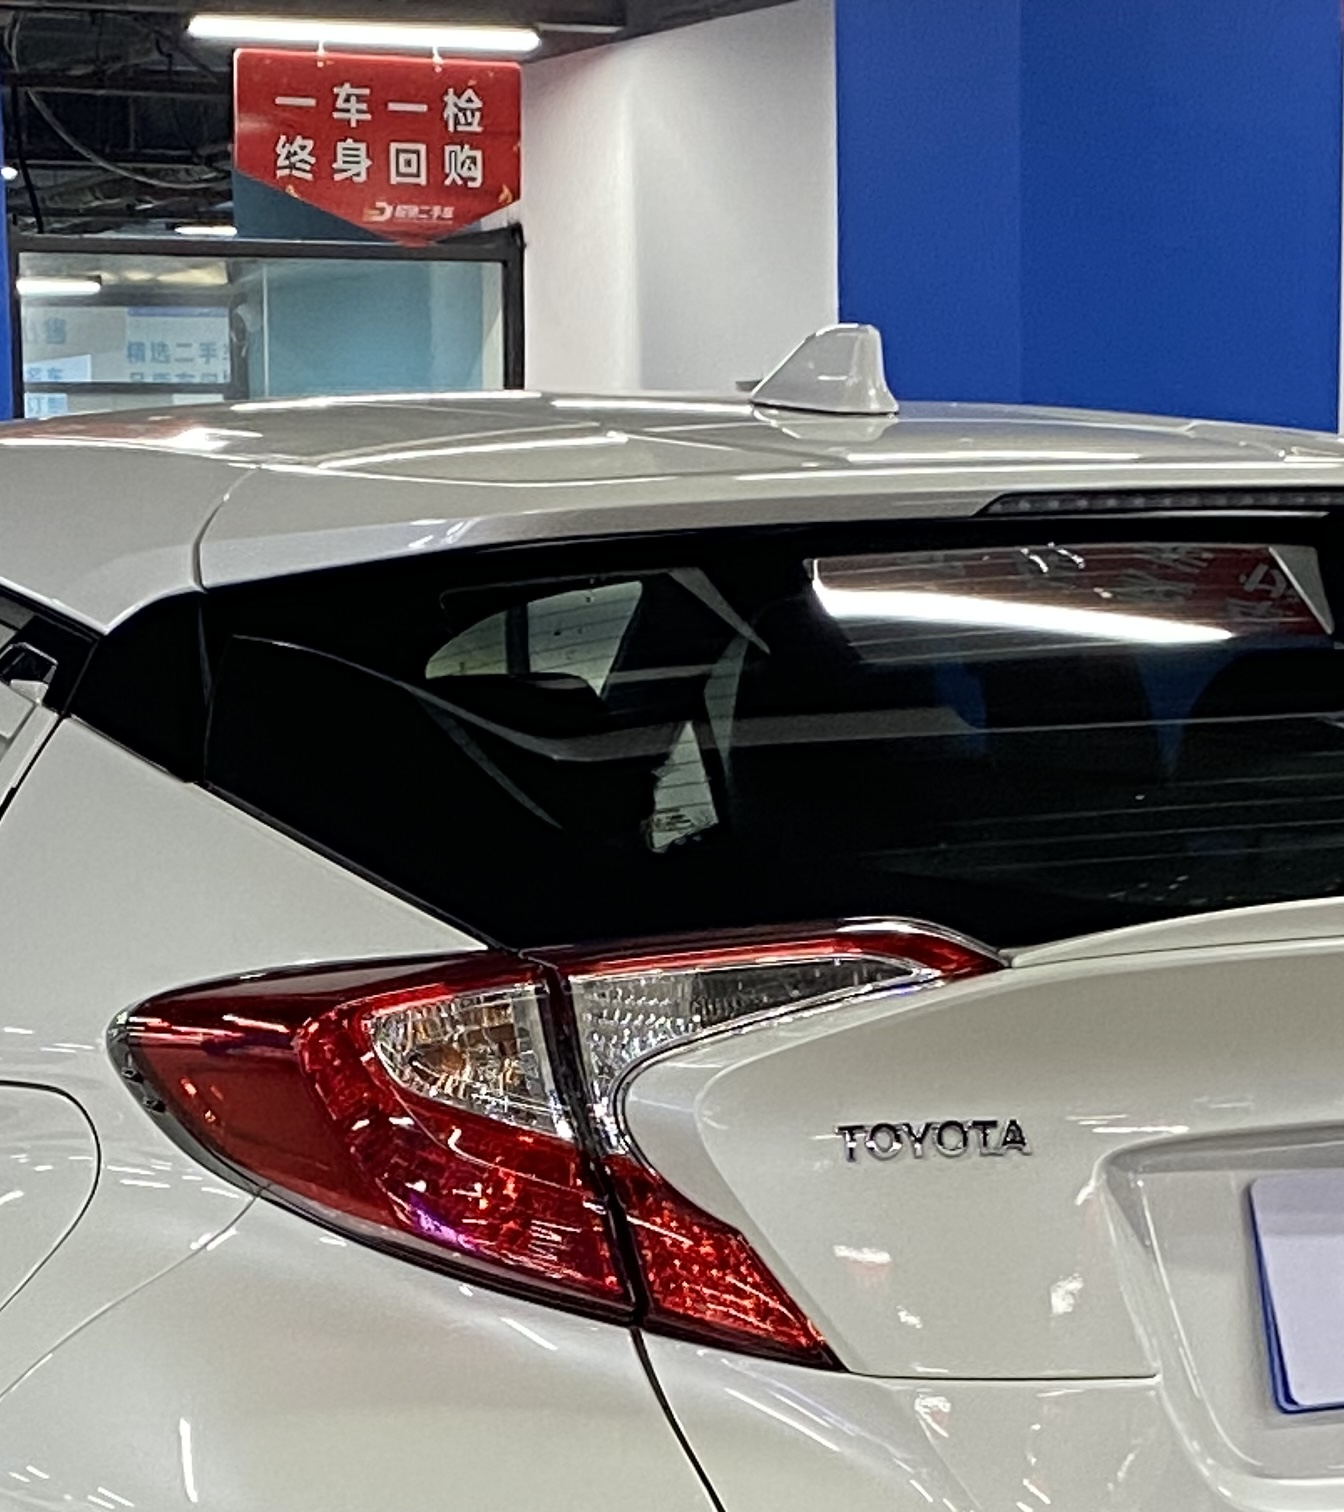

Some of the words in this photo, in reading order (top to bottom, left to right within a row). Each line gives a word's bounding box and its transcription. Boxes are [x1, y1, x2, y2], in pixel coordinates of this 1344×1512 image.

[275, 82, 483, 134] 一车一检
[274, 135, 483, 189] 终身回购
[835, 1119, 1033, 1162] TOYOTA
